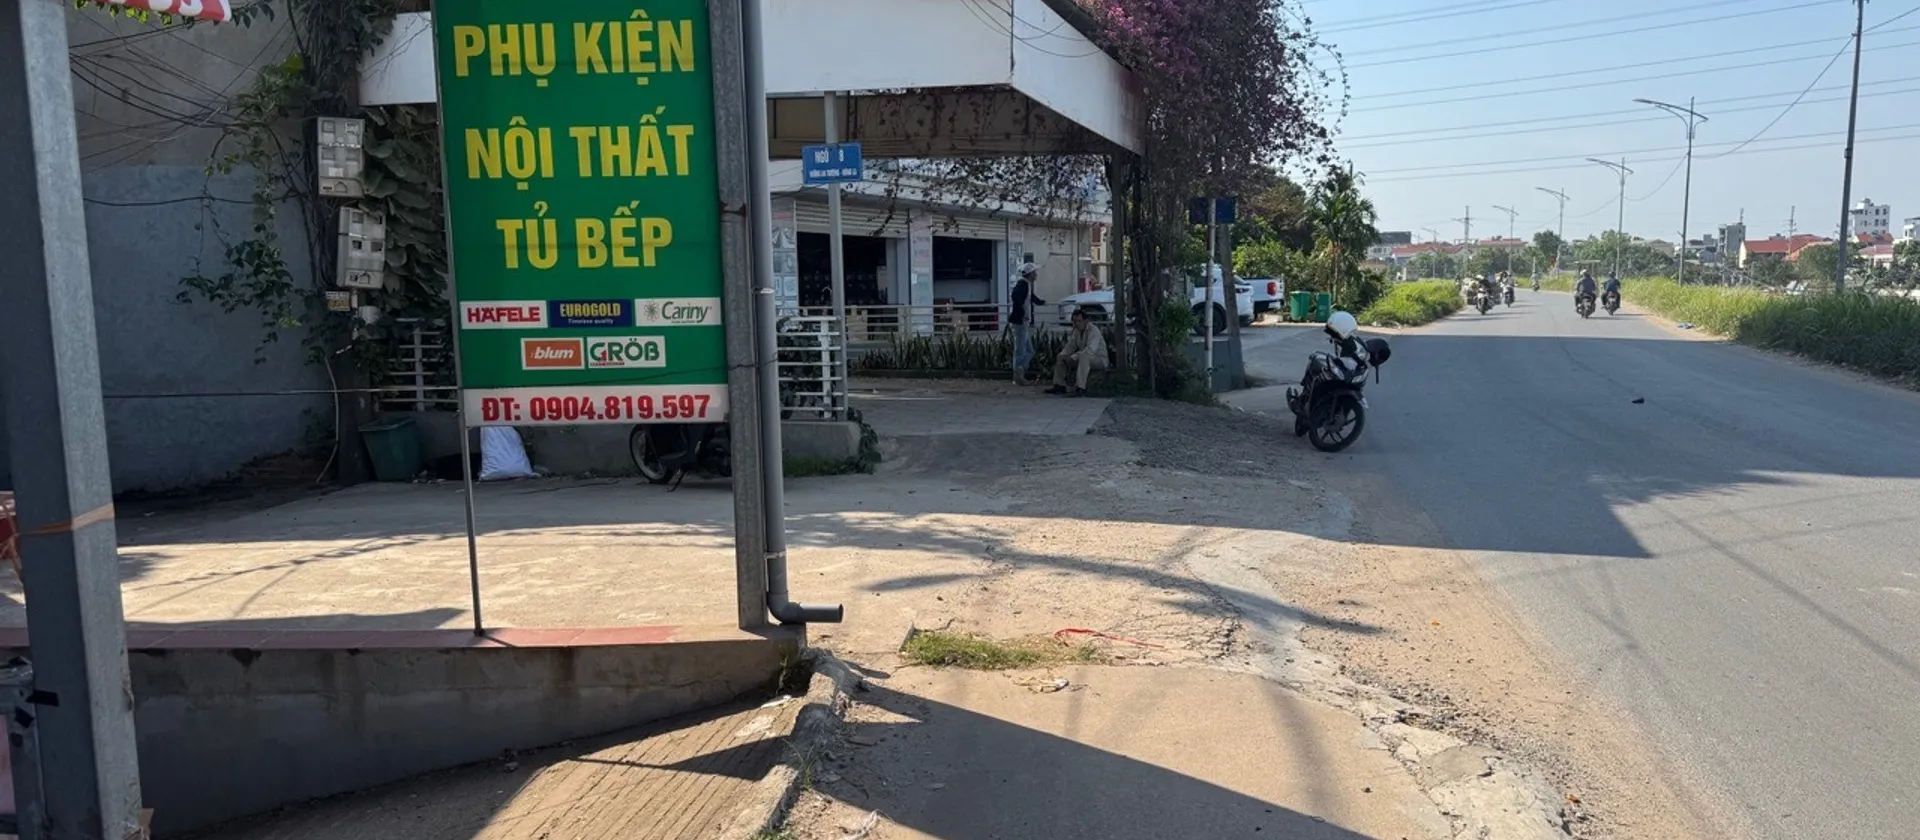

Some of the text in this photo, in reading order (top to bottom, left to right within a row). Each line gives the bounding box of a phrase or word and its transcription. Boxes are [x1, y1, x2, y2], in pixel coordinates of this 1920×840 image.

[454, 9, 694, 86] PHỤ KIỆN
[466, 106, 694, 190] NỘI THẤT
[496, 200, 671, 269] TỦ BẾP
[467, 306, 541, 323] HÄFELE
[560, 303, 621, 317] EUROGOLD
[661, 301, 709, 323] Cariny
[534, 346, 574, 359] blum
[482, 394, 711, 421] ĐT: 0904.819.597
